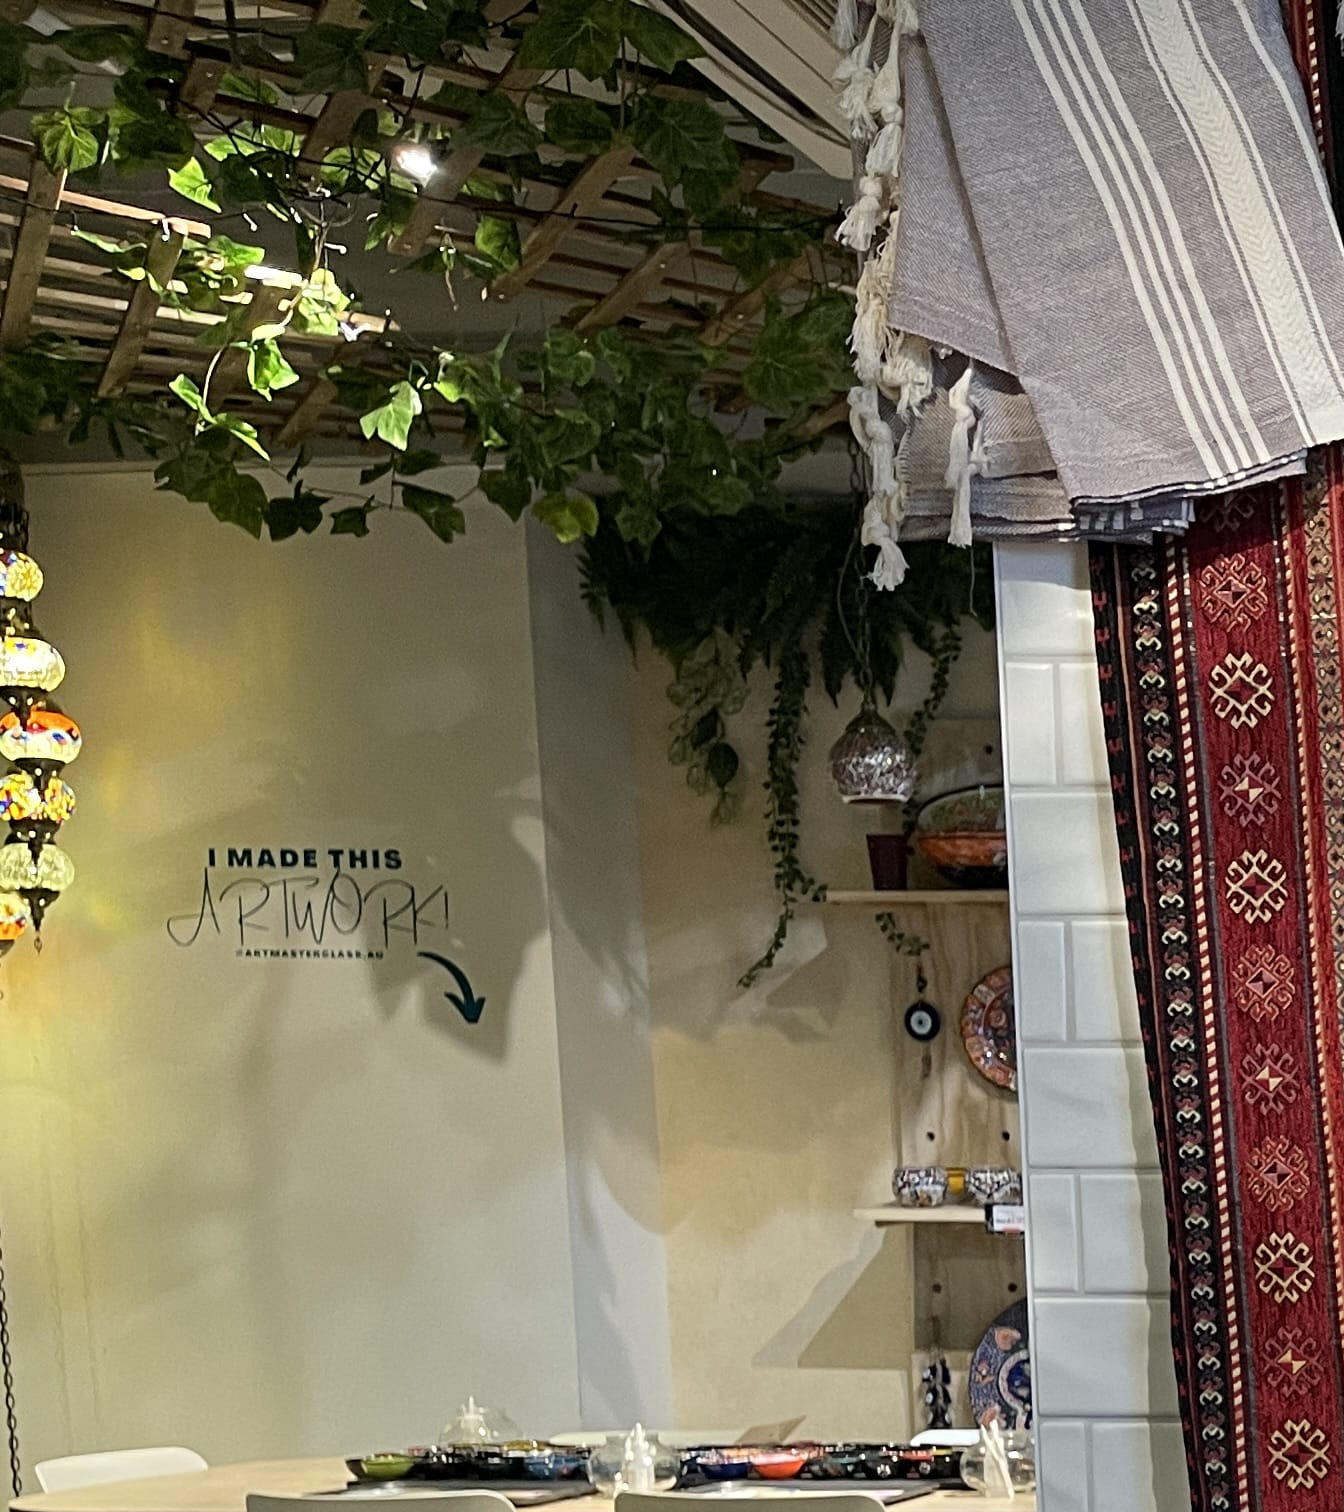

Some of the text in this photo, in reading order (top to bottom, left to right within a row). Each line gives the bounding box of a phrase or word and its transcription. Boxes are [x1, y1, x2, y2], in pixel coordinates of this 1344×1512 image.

[208, 847, 403, 870] I MADE THIS
[166, 867, 449, 949] ARTWORK!
